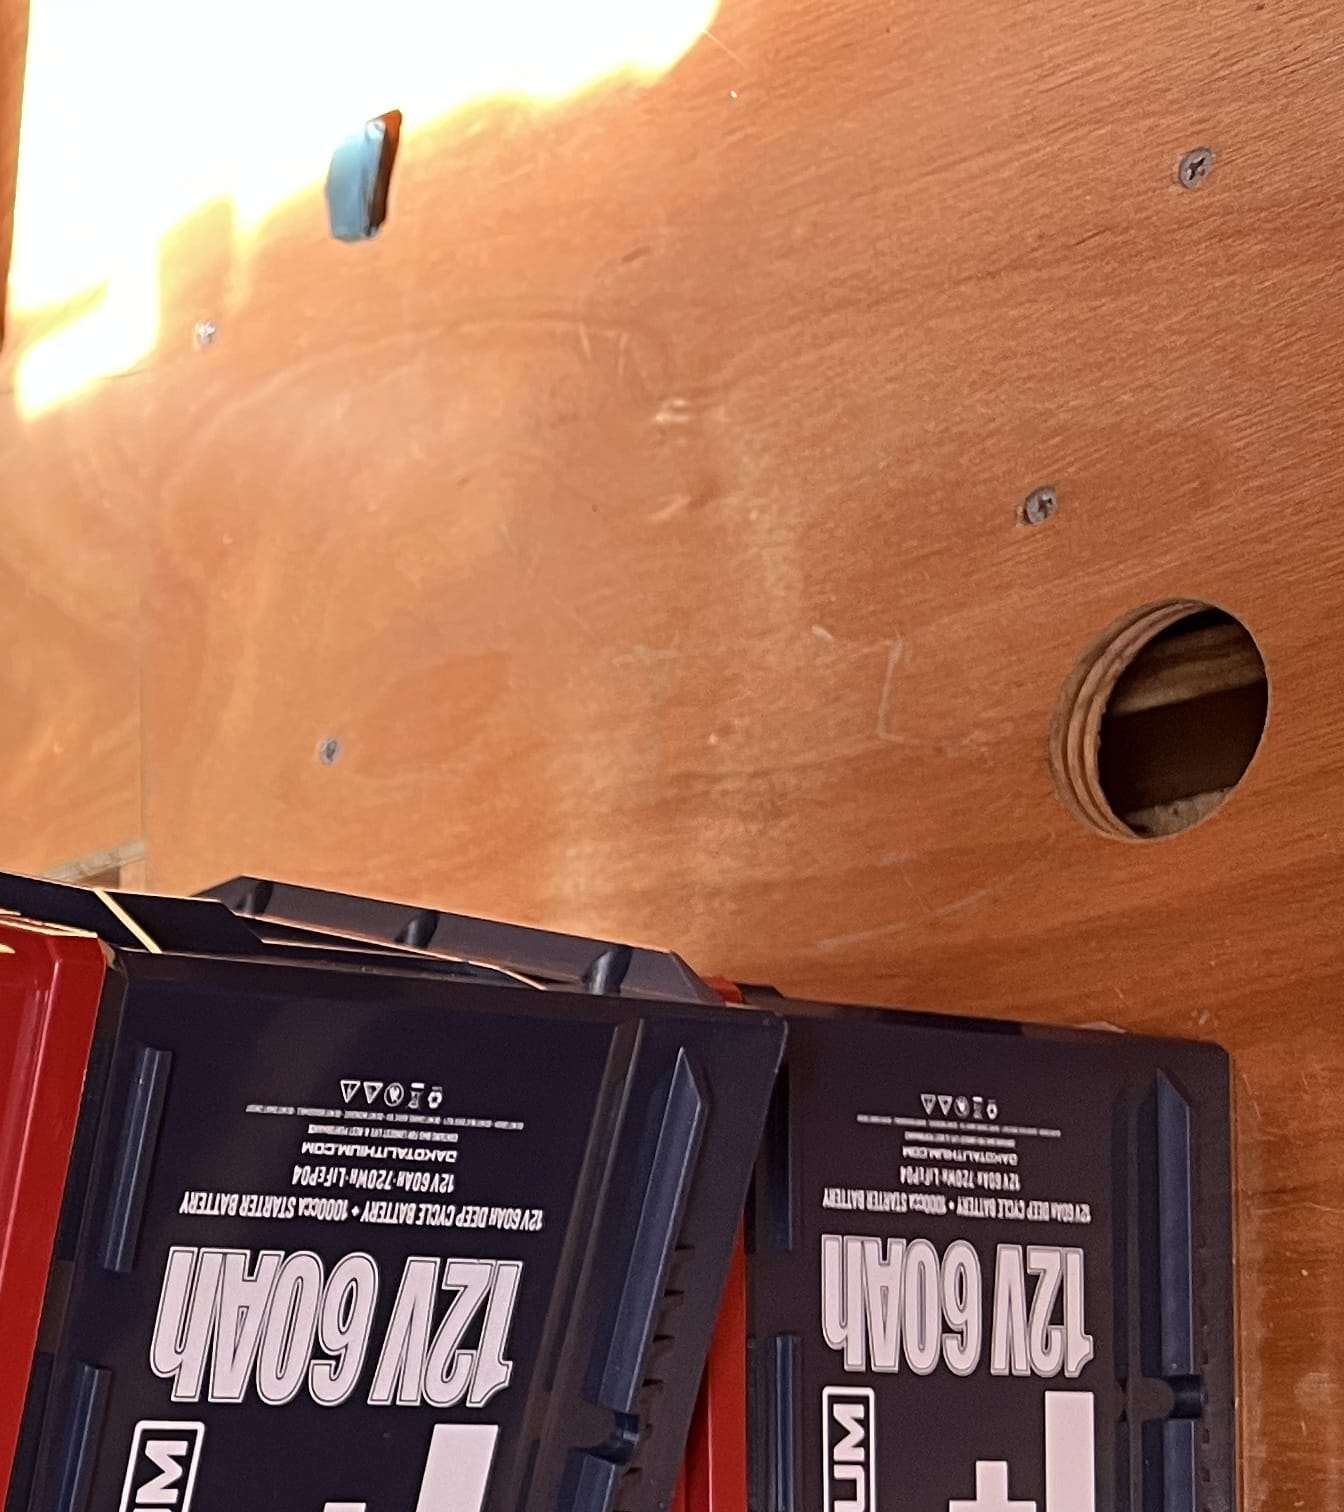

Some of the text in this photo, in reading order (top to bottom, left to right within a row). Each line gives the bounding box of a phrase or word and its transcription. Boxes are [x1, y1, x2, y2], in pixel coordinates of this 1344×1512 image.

[302, 1142, 457, 1162] DAKOTALITHIUM.COM
[430, 1173, 454, 1193] 12V
[179, 1192, 239, 1216] BATTERY
[239, 1195, 296, 1218] STARTER
[360, 1201, 416, 1224] BATTERY
[416, 1204, 456, 1226] CYCLE
[455, 1206, 489, 1228] DEEP
[520, 1210, 543, 1231] 12V
[821, 1234, 1093, 1377] 12V 60Ah
[150, 1246, 523, 1408] 12V 60Ah
